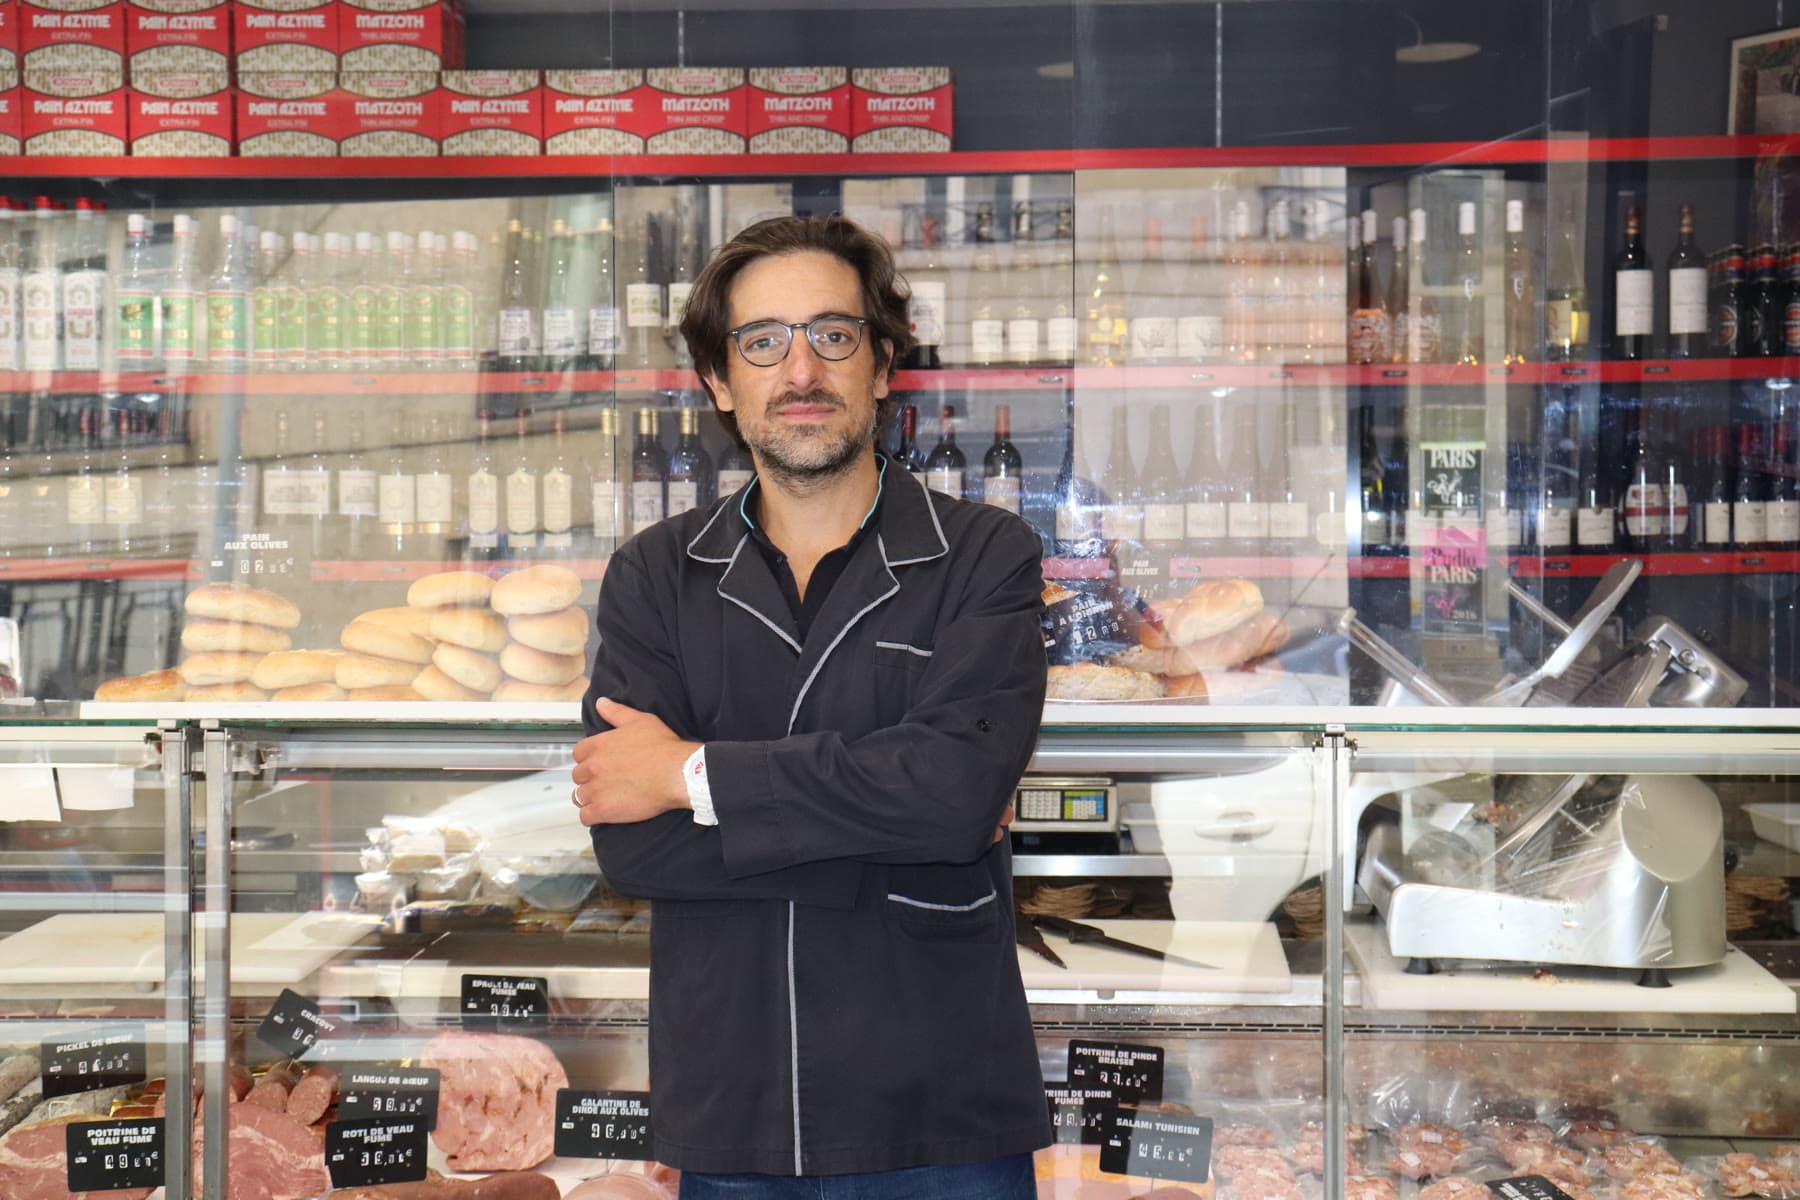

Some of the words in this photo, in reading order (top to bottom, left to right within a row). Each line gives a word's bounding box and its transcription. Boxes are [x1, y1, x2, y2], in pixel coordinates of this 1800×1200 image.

[32, 15, 61, 28] PAIN
[63, 15, 111, 28] AZYME
[138, 16, 167, 30] PAIN
[169, 16, 216, 30] AZYME
[246, 15, 276, 28] PAIN
[278, 15, 326, 28] AZYME
[356, 15, 424, 29] MATZOTH
[34, 100, 62, 114] PAIN
[65, 100, 112, 114] AZYME
[141, 102, 169, 115] PAIN
[172, 102, 219, 115] AZYME
[249, 102, 277, 115] PAIN
[280, 102, 327, 115] AZYME
[355, 102, 422, 115] MATZOTH
[451, 100, 480, 112] PAIN
[482, 100, 529, 112] AZYME
[555, 99, 584, 112] PAIN
[586, 99, 633, 112] AZYME
[662, 98, 730, 111] MATZOTH
[764, 97, 832, 111] MATZOTH
[868, 98, 935, 111] MATZOTH
[1431, 448, 1476, 468] PARIS
[1450, 493, 1475, 505] 217
[242, 533, 270, 541] PAIN
[224, 542, 248, 550] AUX
[250, 541, 288, 549] OLIVES
[1431, 566, 1477, 584] PARIS
[1072, 598, 1096, 612] PAIN
[56, 1042, 90, 1053] PICKEL
[91, 1039, 104, 1047] DE
[1076, 1047, 1116, 1058] POITRINE
[1131, 1052, 1158, 1061] DINDE
[388, 1076, 400, 1084] DE
[1085, 1090, 1112, 1098] DINDE
[581, 1098, 628, 1107] GALANTINE
[629, 1100, 640, 1108] DE
[572, 1106, 598, 1114] DINDE
[600, 1107, 618, 1115] AUX
[620, 1108, 649, 1116] OLIVES
[87, 1128, 138, 1137] POITRINE
[142, 1126, 156, 1135] DE
[342, 1129, 367, 1138] ROTI
[370, 1127, 384, 1136] DE
[387, 1125, 414, 1134] VEAU
[1116, 1118, 1152, 1129] SALAMI
[1155, 1122, 1200, 1135] TUNISIEN
[91, 1137, 120, 1146] VEAU
